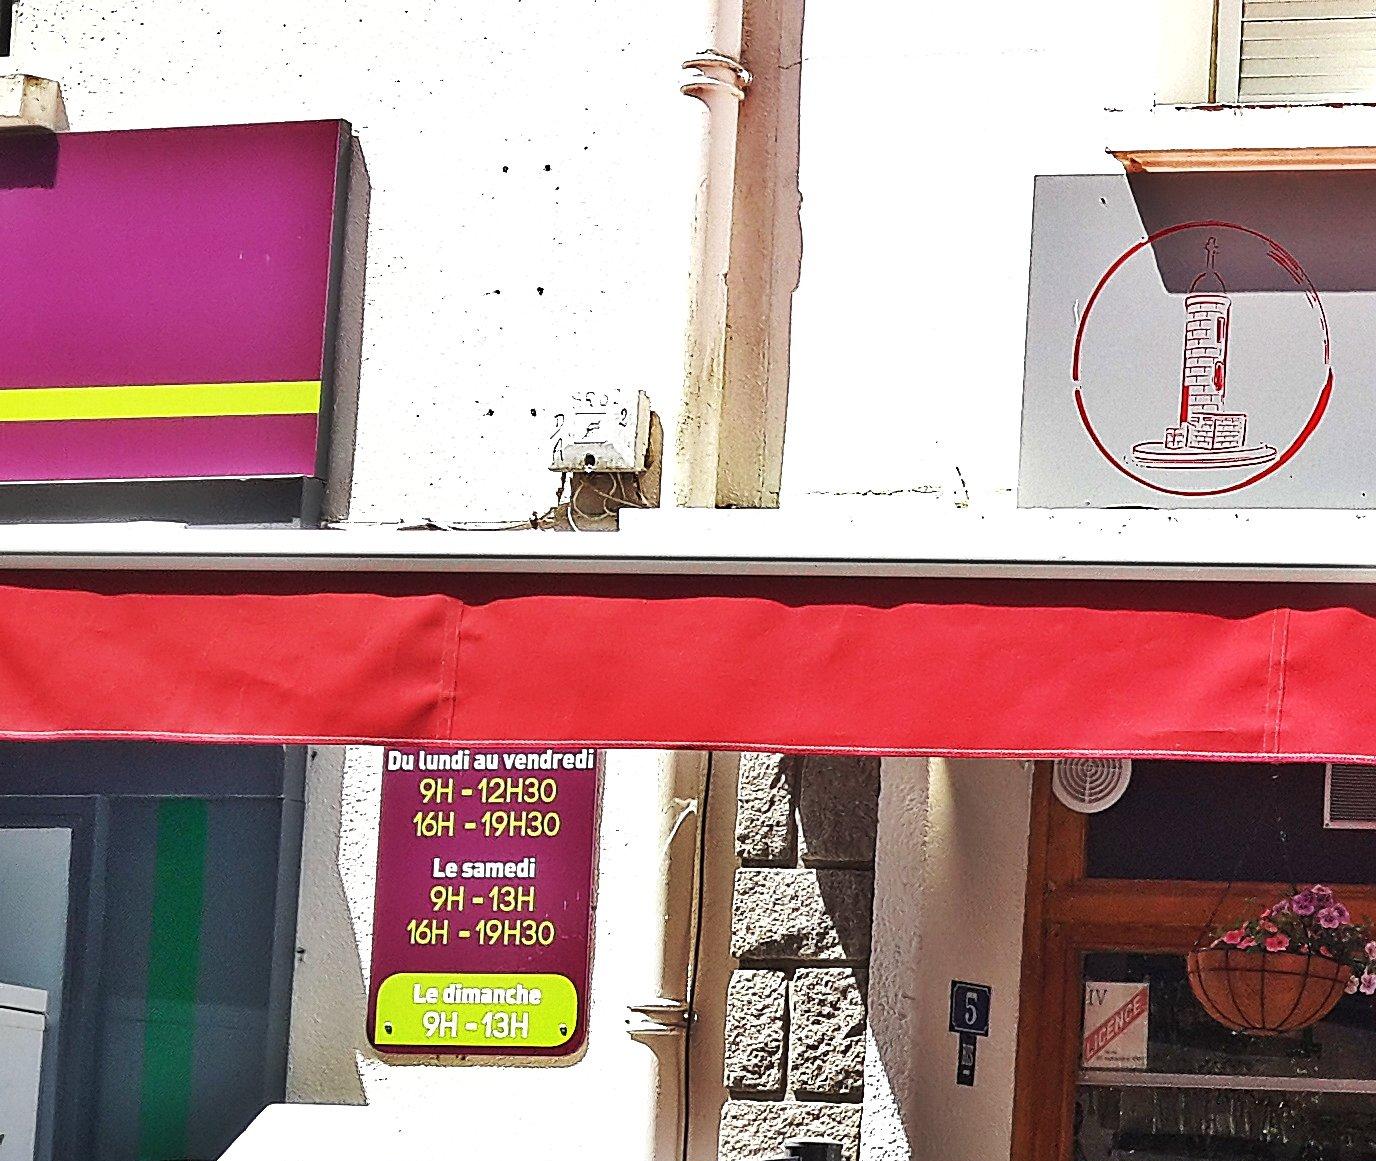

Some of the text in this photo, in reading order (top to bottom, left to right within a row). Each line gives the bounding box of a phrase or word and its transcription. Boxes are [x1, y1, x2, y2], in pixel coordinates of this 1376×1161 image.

[387, 748, 595, 771] Du lundi au vendredi
[418, 777, 454, 805] 9H
[477, 777, 557, 804] 12H30
[412, 811, 455, 838] 16H
[481, 810, 562, 838] 19H30
[432, 856, 536, 879] Le samedi
[430, 885, 465, 913] 9H
[488, 885, 536, 912] 13H
[407, 919, 449, 945] 16H
[475, 918, 555, 946] 19H30
[412, 983, 543, 1005] Le dimanche
[1088, 988, 1108, 1007] IV
[964, 991, 978, 1026] 5
[422, 1011, 459, 1039] 9H
[480, 1011, 530, 1039] 13H
[1085, 992, 1144, 1061] LICENCE
